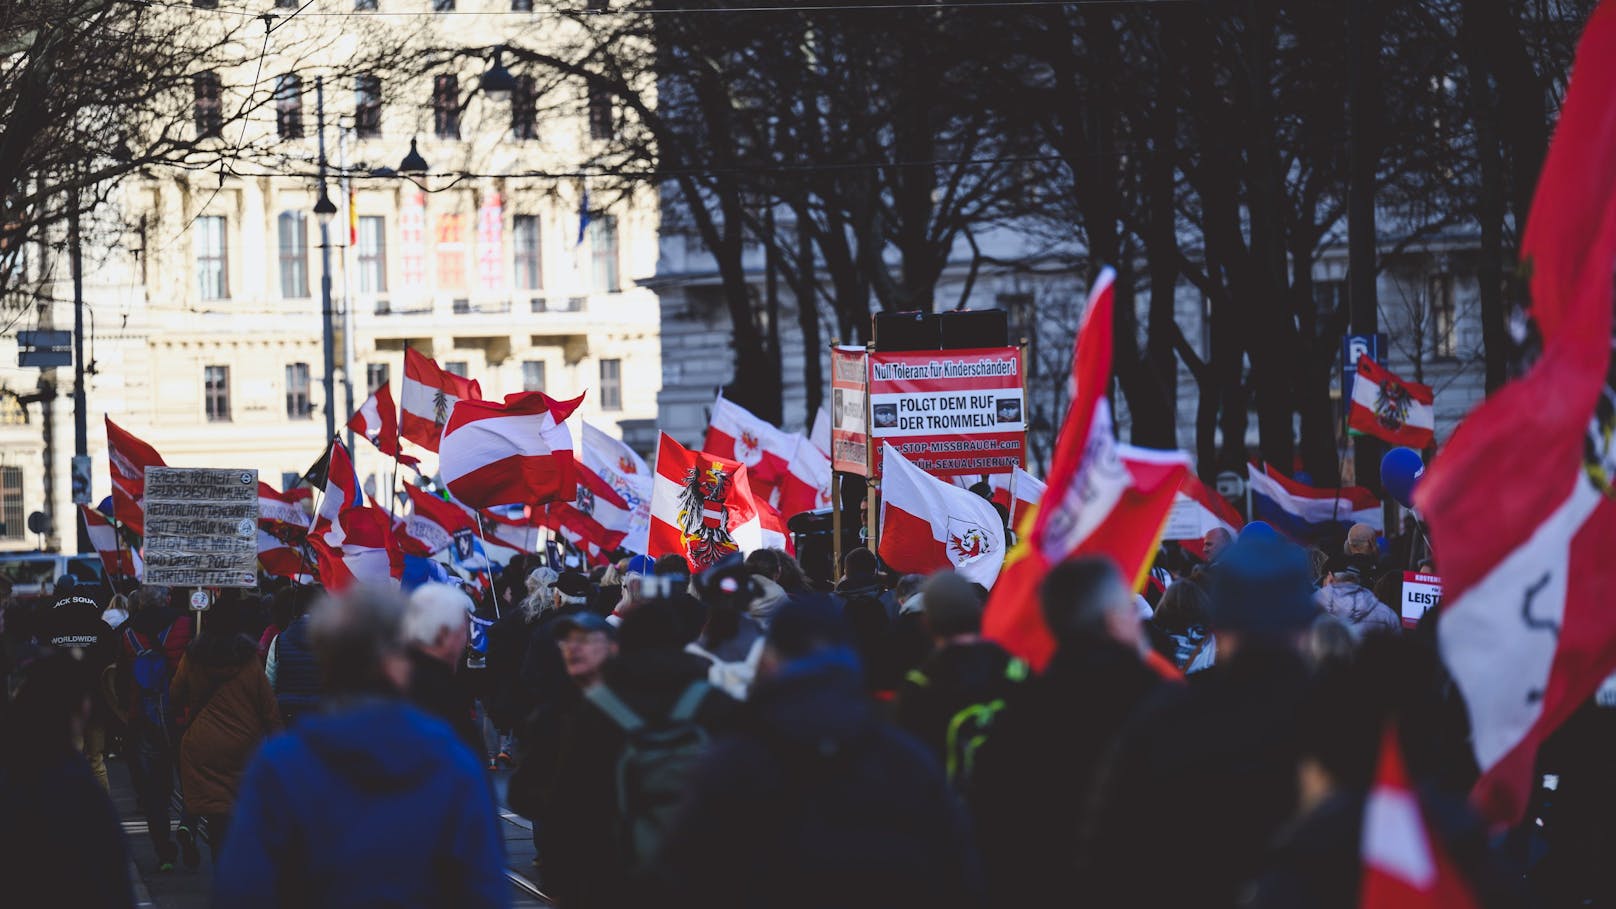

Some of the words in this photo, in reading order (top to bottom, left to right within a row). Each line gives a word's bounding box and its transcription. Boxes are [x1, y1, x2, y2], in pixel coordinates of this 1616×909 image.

[874, 364, 892, 379] Null
[893, 363, 929, 379] Toleranz
[930, 361, 943, 377] für
[944, 359, 1011, 377] Kinderschänder
[900, 398, 937, 412] FOLGT
[940, 397, 967, 410] DEM
[971, 395, 994, 409] RUF
[900, 416, 924, 430] DER
[927, 413, 995, 429] TROMMELN
[878, 440, 1020, 455] ww.STOP-MISSBRAUCH.com
[911, 456, 1020, 470] RÜH-SEXUALISIERUNG
[52, 635, 97, 644] WORLDWIDE
